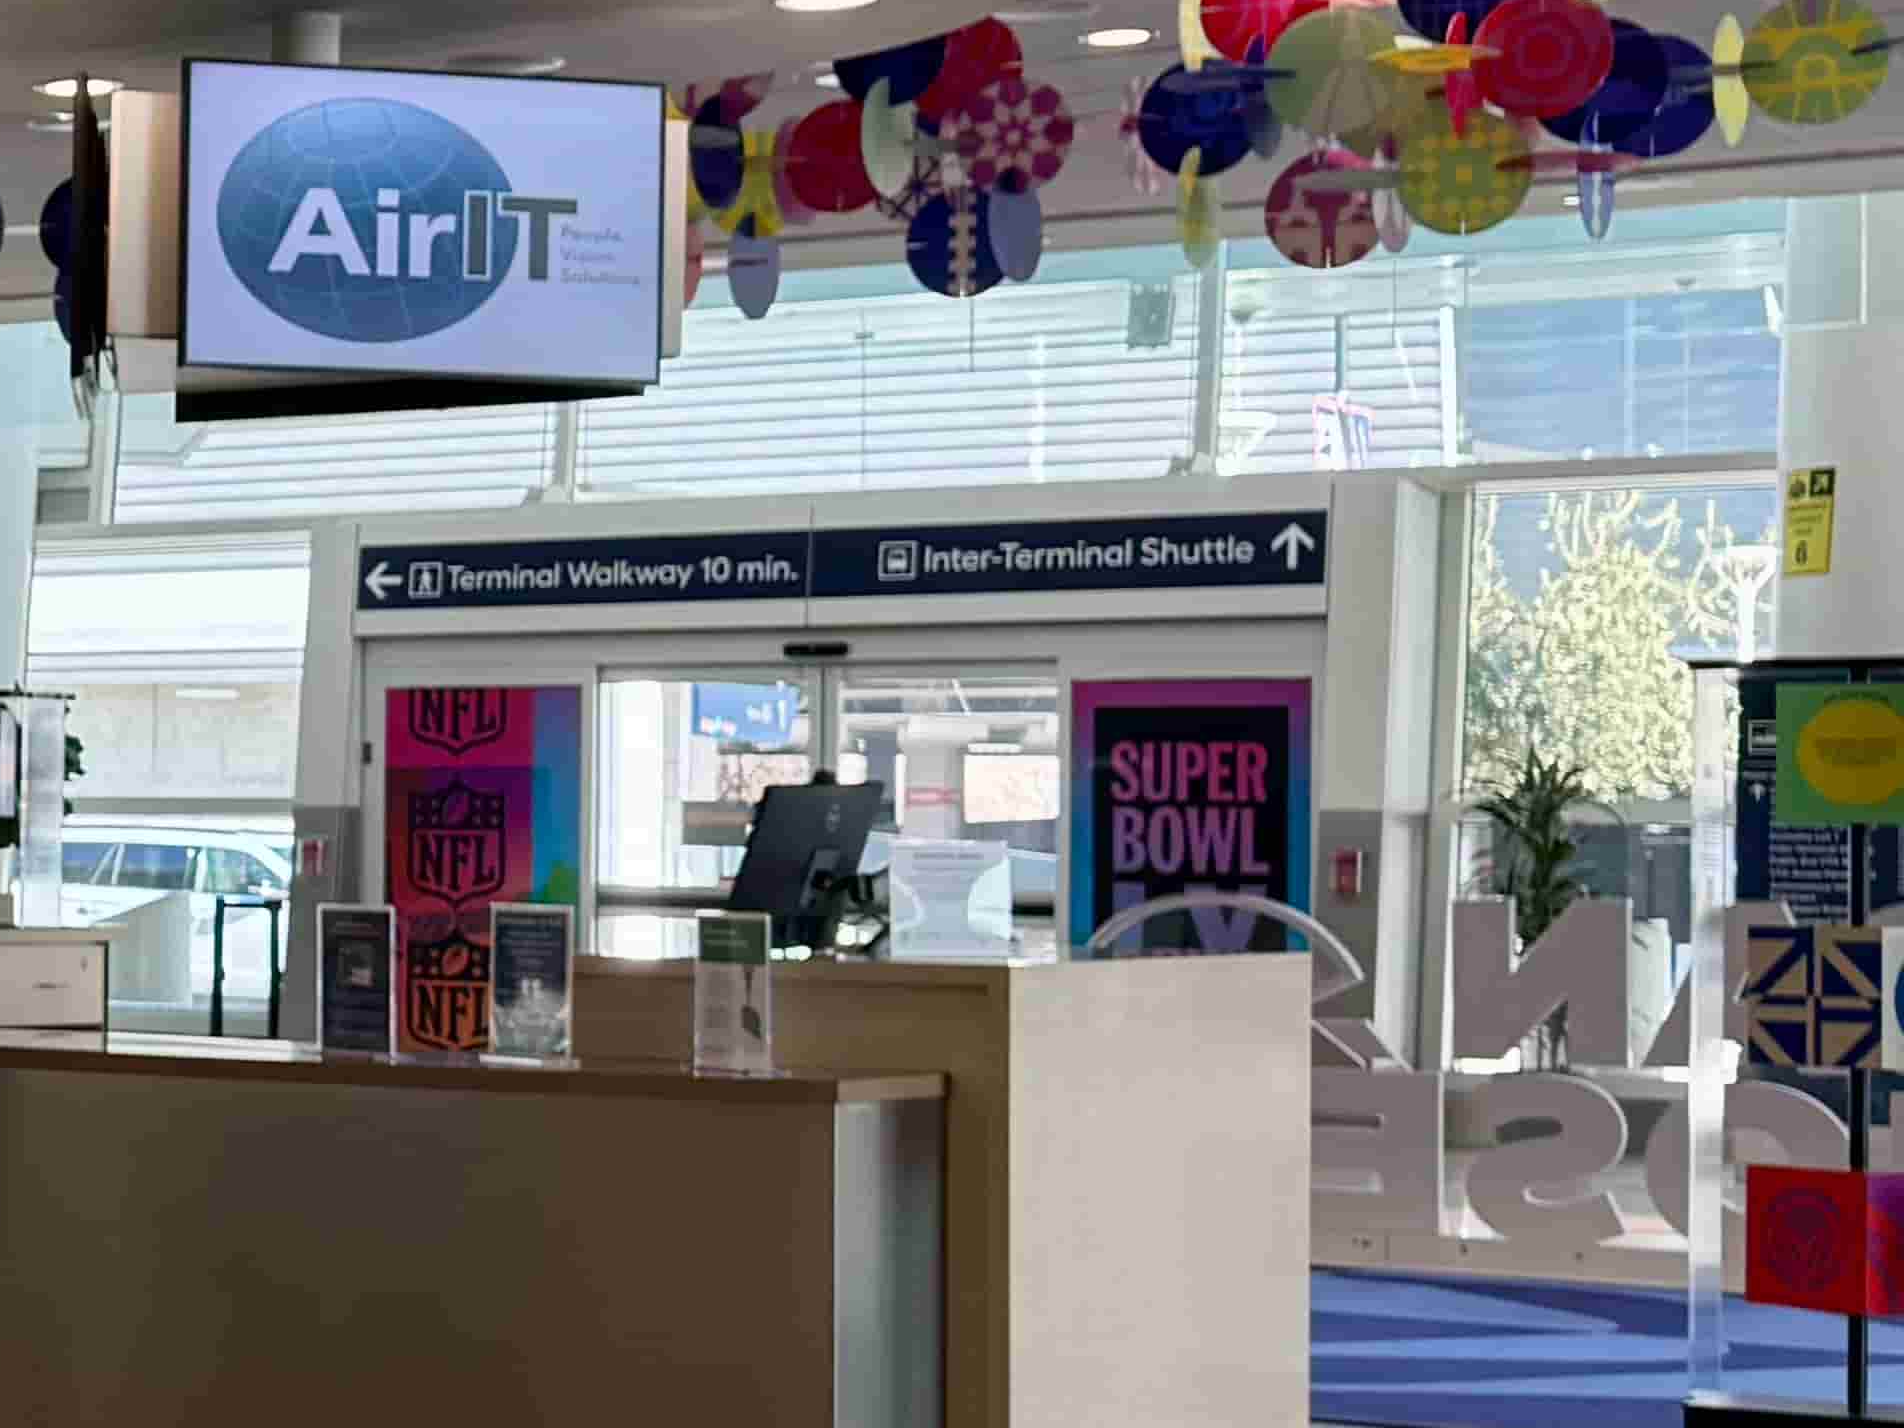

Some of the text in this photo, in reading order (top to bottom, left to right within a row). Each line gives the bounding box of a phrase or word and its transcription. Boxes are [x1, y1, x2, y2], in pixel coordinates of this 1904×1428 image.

[448, 554, 798, 593] Terminal Walkway 10 min.
[923, 534, 1256, 573] Inter-Terminal Shuttle
[414, 689, 498, 741] NFL
[1110, 740, 1269, 804] SUPER
[414, 831, 497, 890] NFL
[1111, 805, 1271, 876] BOWL
